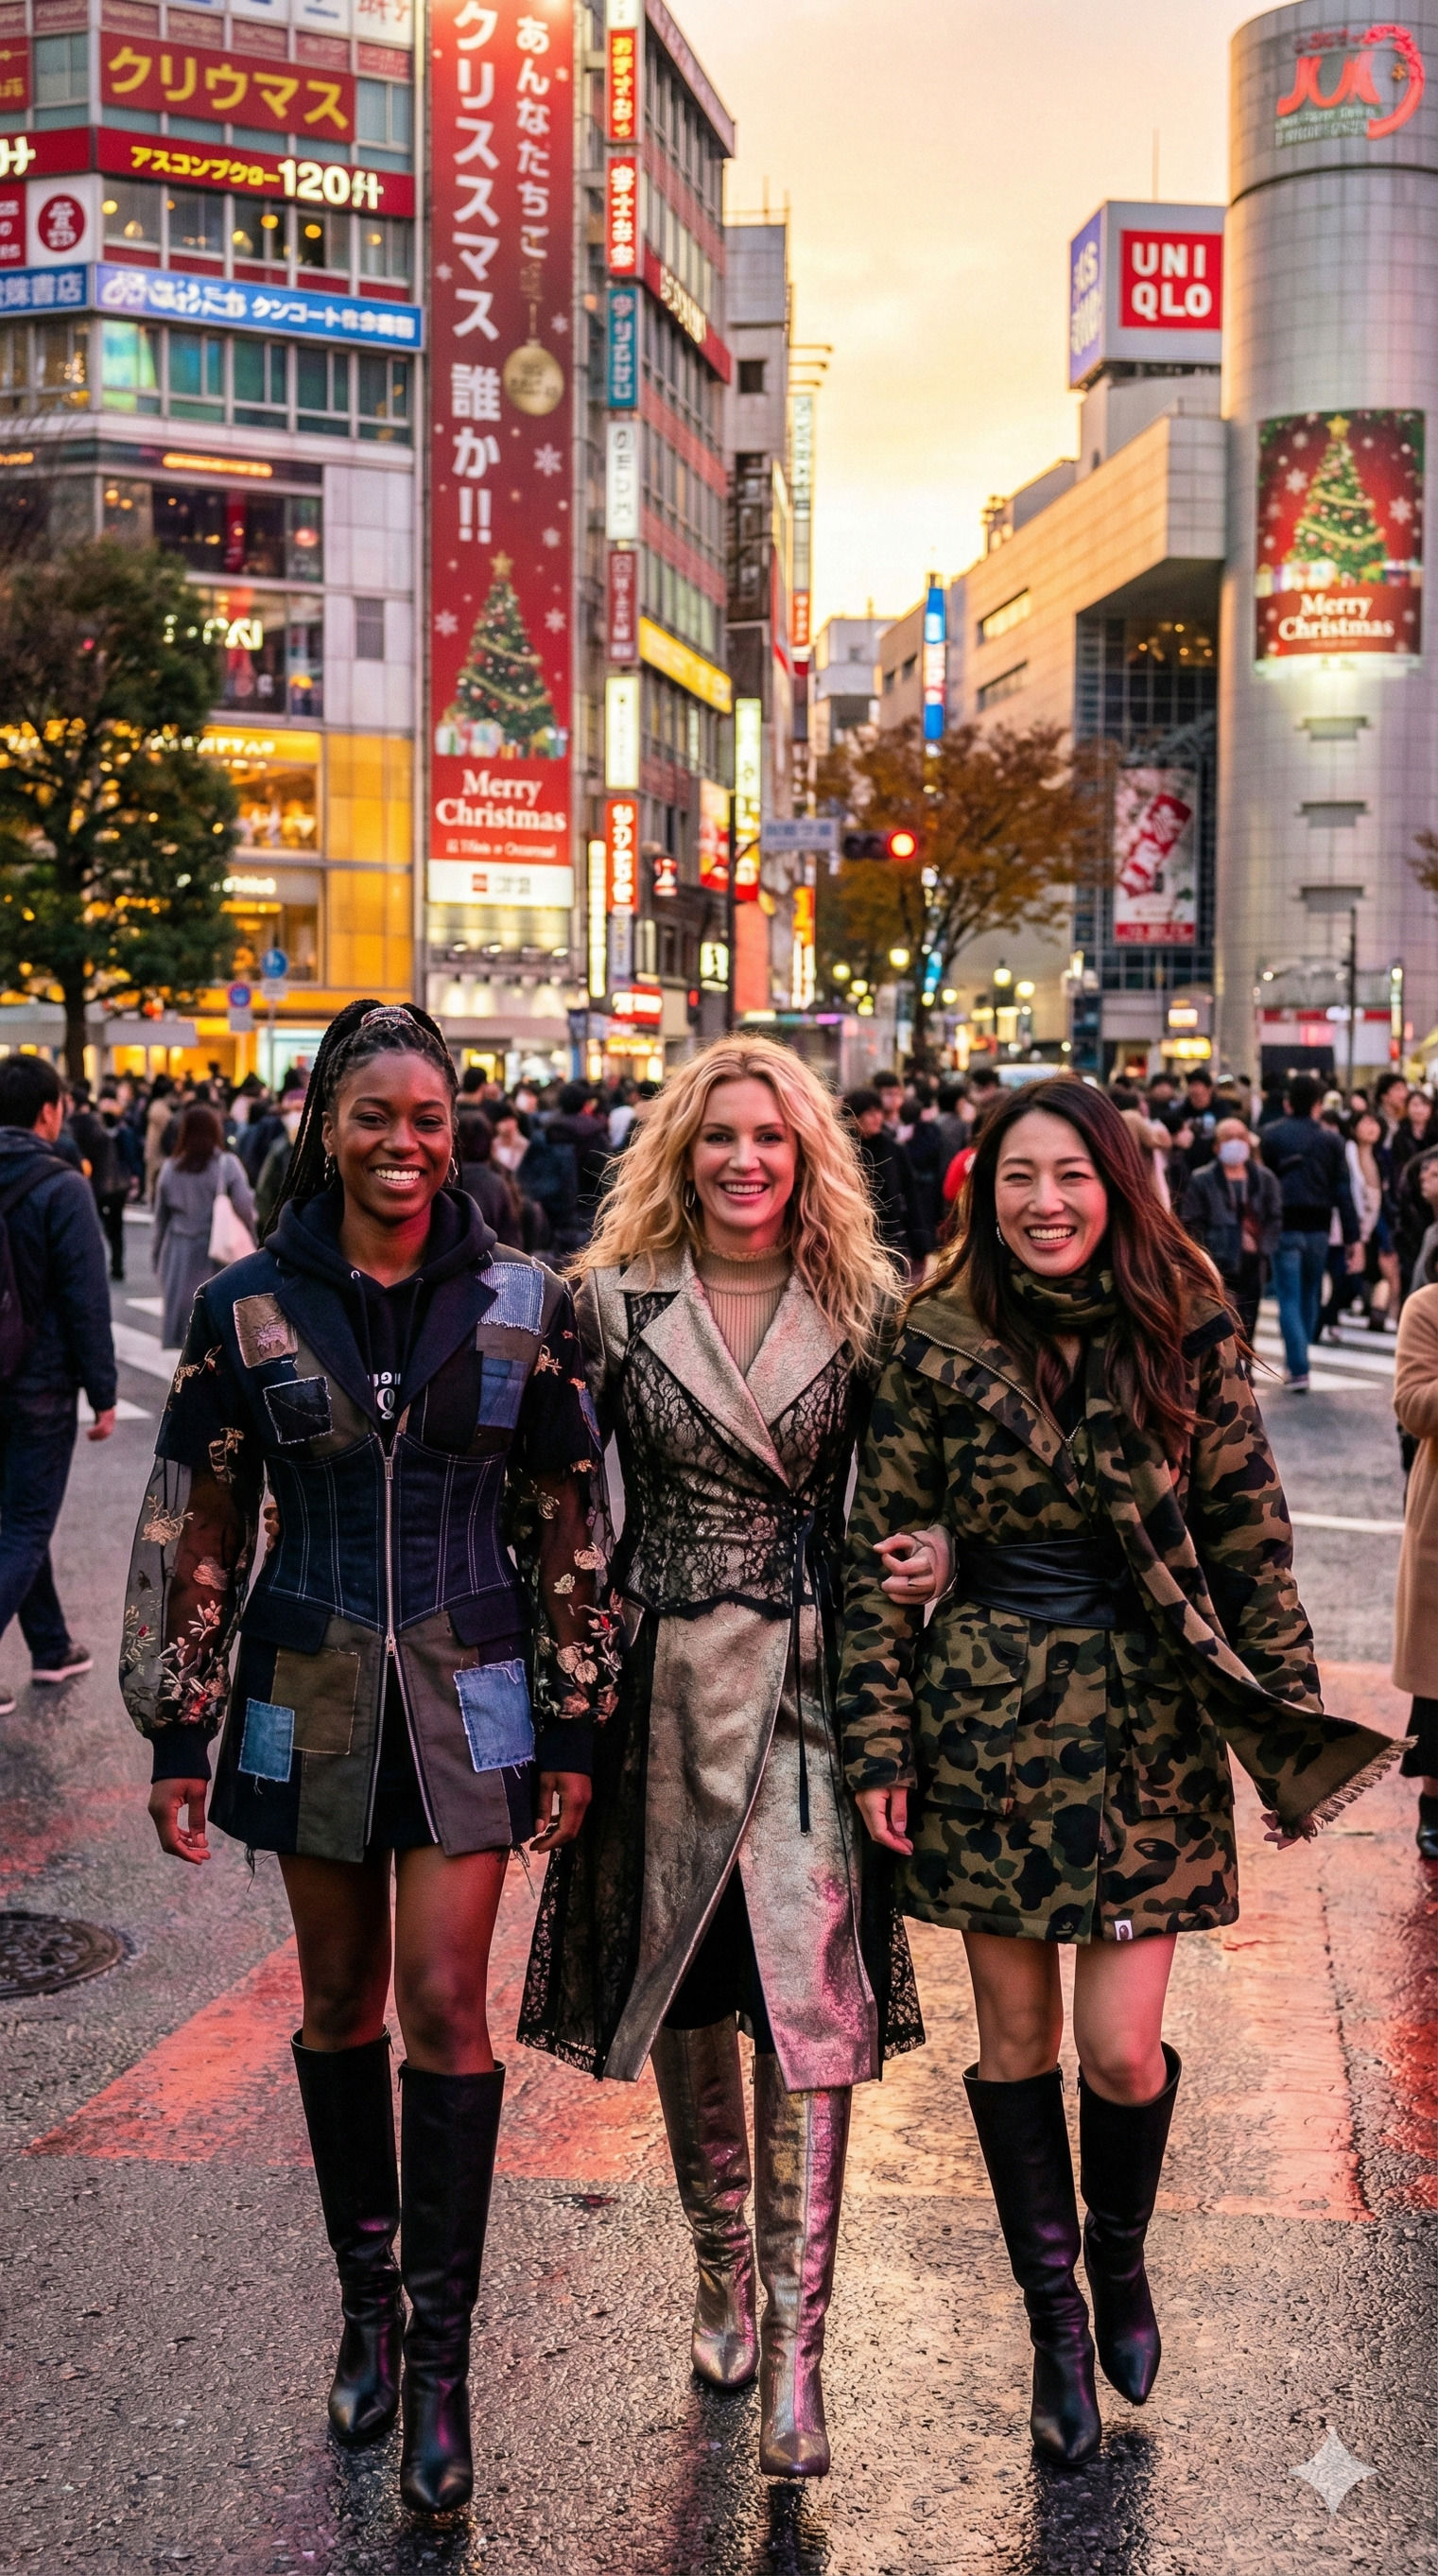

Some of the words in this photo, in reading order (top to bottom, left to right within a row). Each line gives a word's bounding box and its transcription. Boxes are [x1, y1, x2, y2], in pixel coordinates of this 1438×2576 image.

[108, 45, 350, 131] クリウマス
[451, 1, 501, 342] クリススマス
[1131, 241, 1207, 279] UNI
[1131, 282, 1213, 322] QLO
[1300, 592, 1373, 619] Merry
[1278, 615, 1395, 642] Christmas
[461, 769, 543, 808] Merry
[435, 797, 567, 832] Christmas
